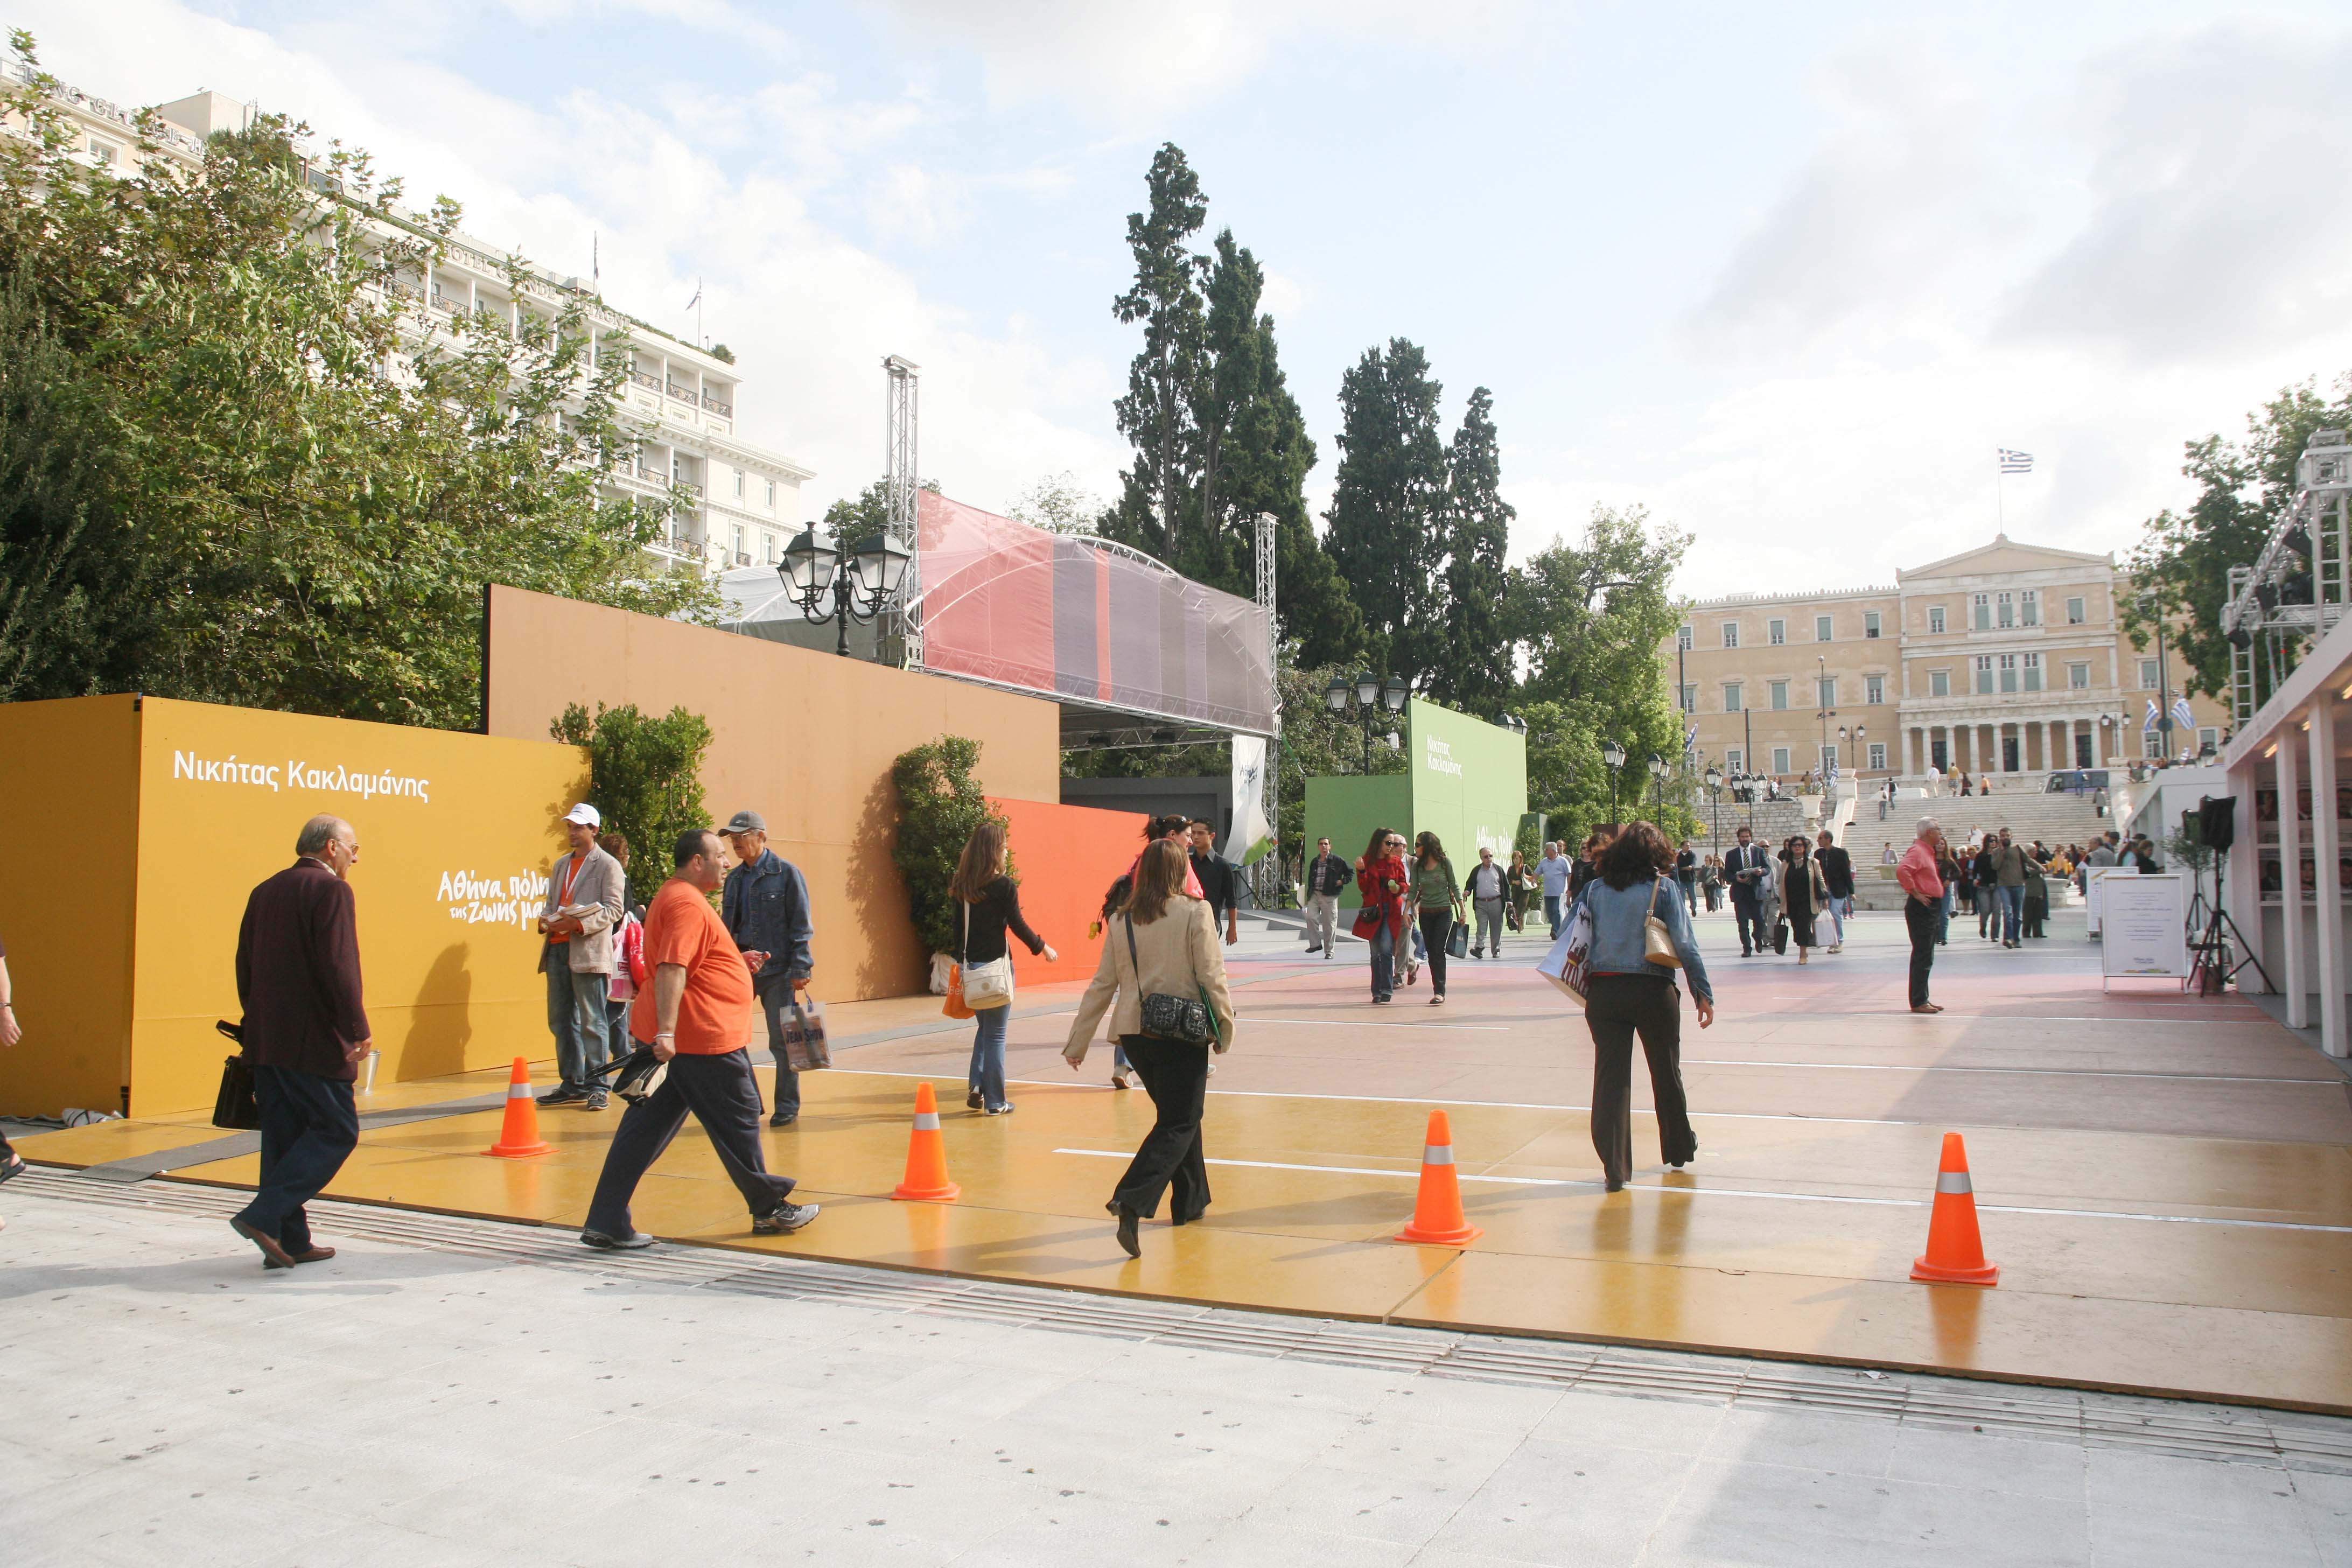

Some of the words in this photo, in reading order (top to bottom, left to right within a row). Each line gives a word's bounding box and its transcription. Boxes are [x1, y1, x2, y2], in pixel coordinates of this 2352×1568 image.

[1427, 734, 1450, 760] Νικήτας
[174, 750, 279, 792] Νικήτας
[288, 760, 429, 803] Κακλαμάνης
[1427, 752, 1462, 780] Κακλαμάνης
[437, 870, 506, 901] Αθήνα,
[449, 906, 467, 920] της
[521, 901, 547, 931] μα
